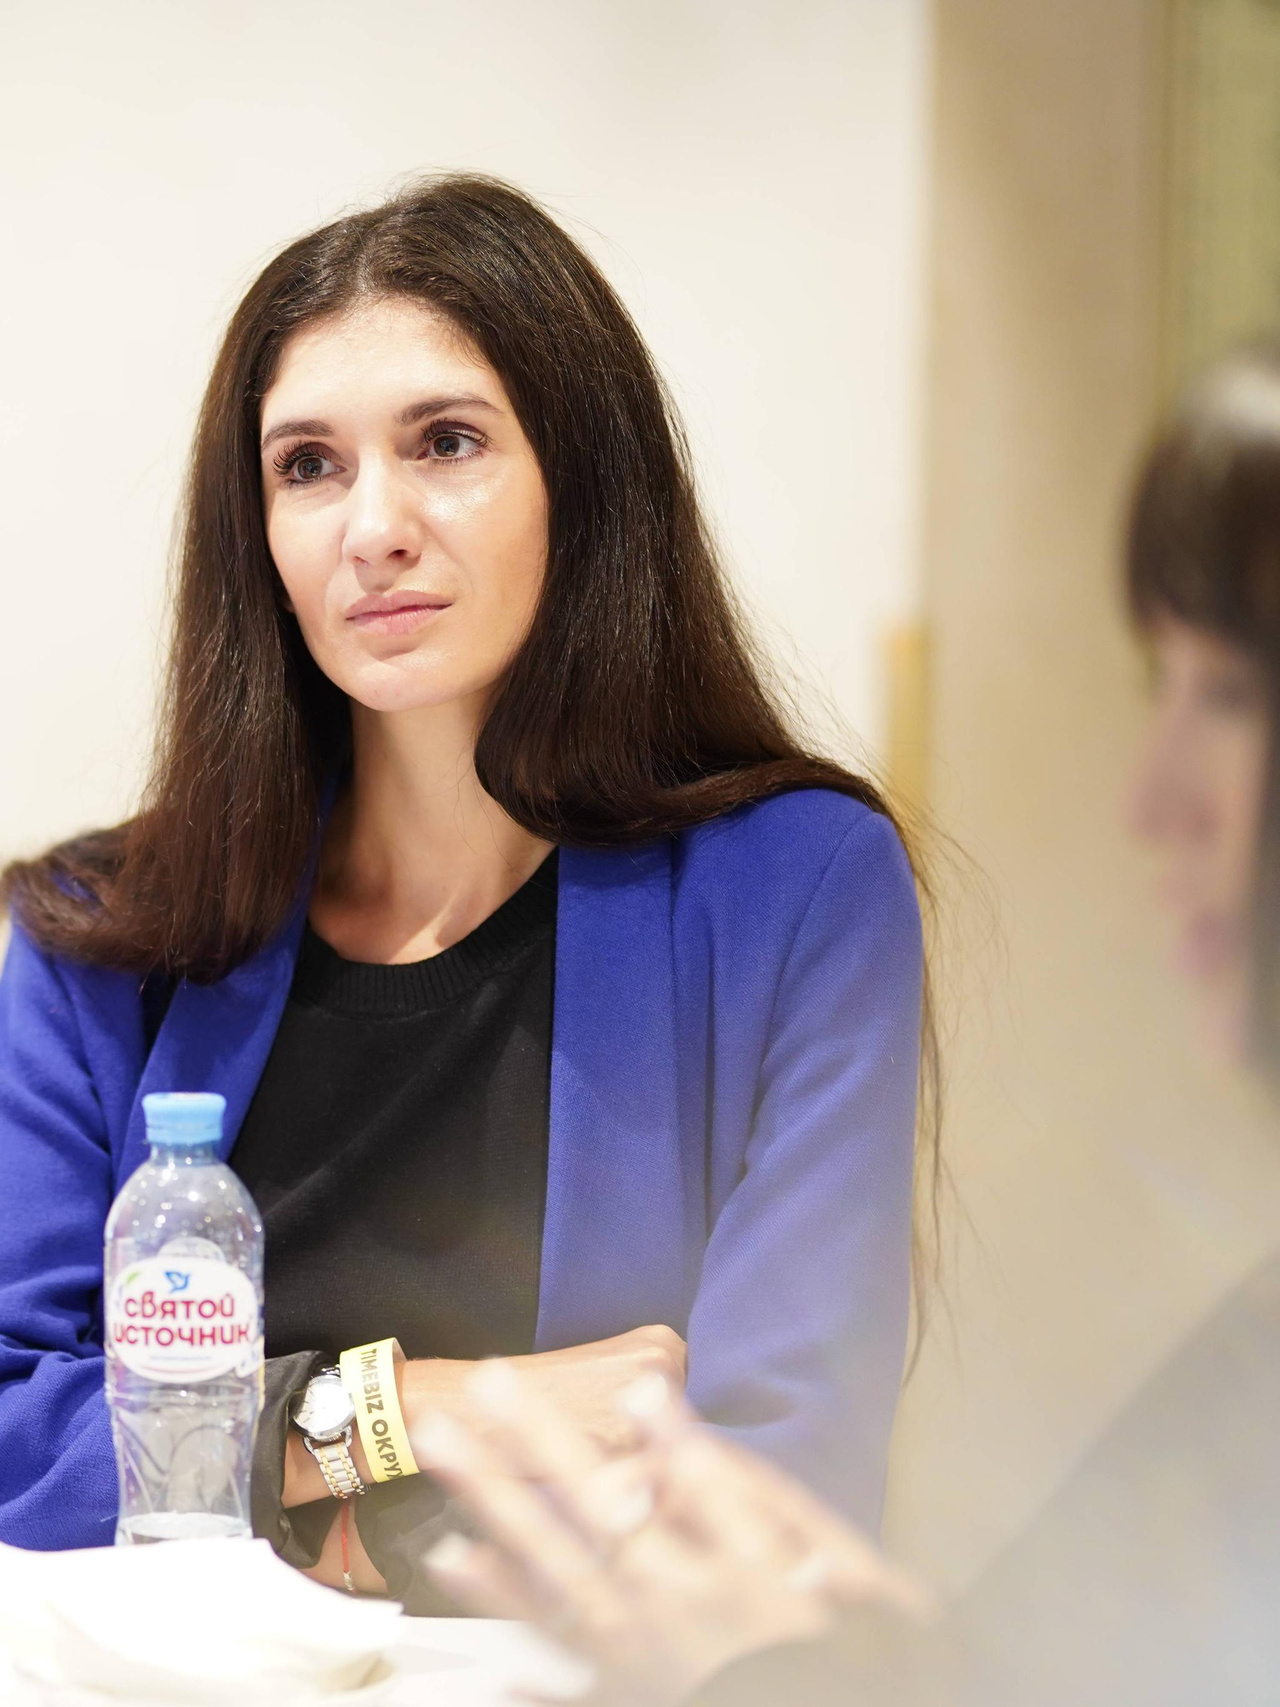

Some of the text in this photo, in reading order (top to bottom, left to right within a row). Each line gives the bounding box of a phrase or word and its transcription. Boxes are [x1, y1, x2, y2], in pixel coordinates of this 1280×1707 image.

[125, 1291, 235, 1319] СВЯТОЙ
[114, 1323, 250, 1346] ИСТОЧНИК
[360, 1348, 384, 1414] TIMEBIZ
